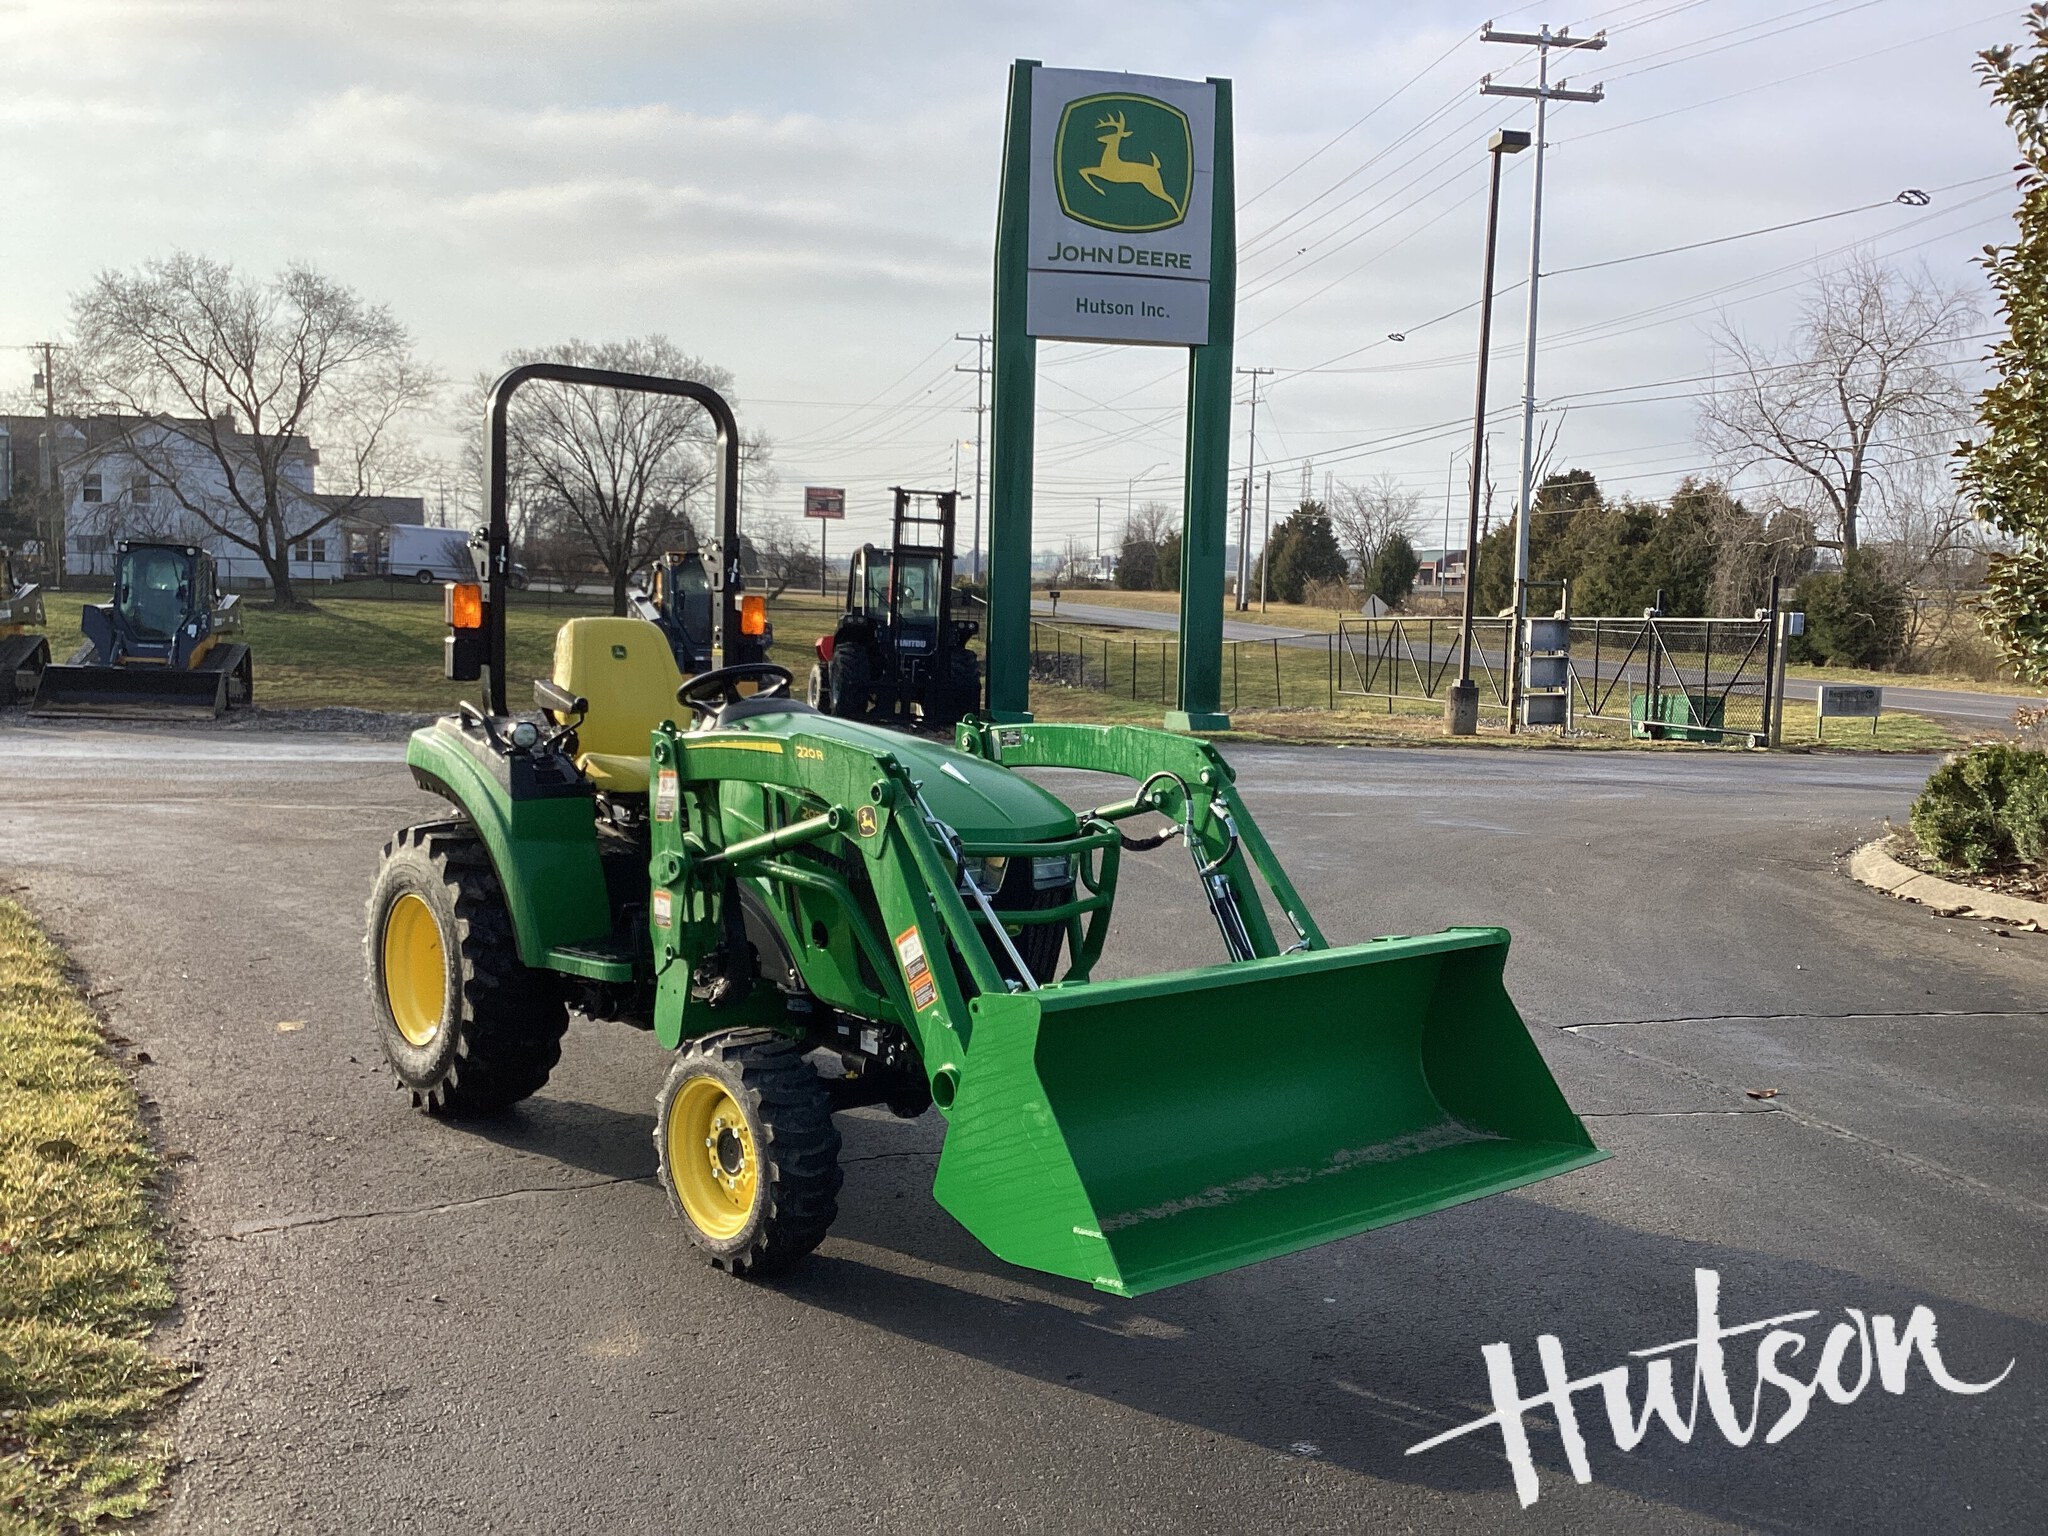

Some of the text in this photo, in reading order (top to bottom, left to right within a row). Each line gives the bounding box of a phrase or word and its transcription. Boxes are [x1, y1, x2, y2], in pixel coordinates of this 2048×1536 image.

[1048, 242, 1191, 269] JOHN DEERE
[1076, 297, 1170, 318] Hutson Inc.
[795, 745, 824, 761] 220R
